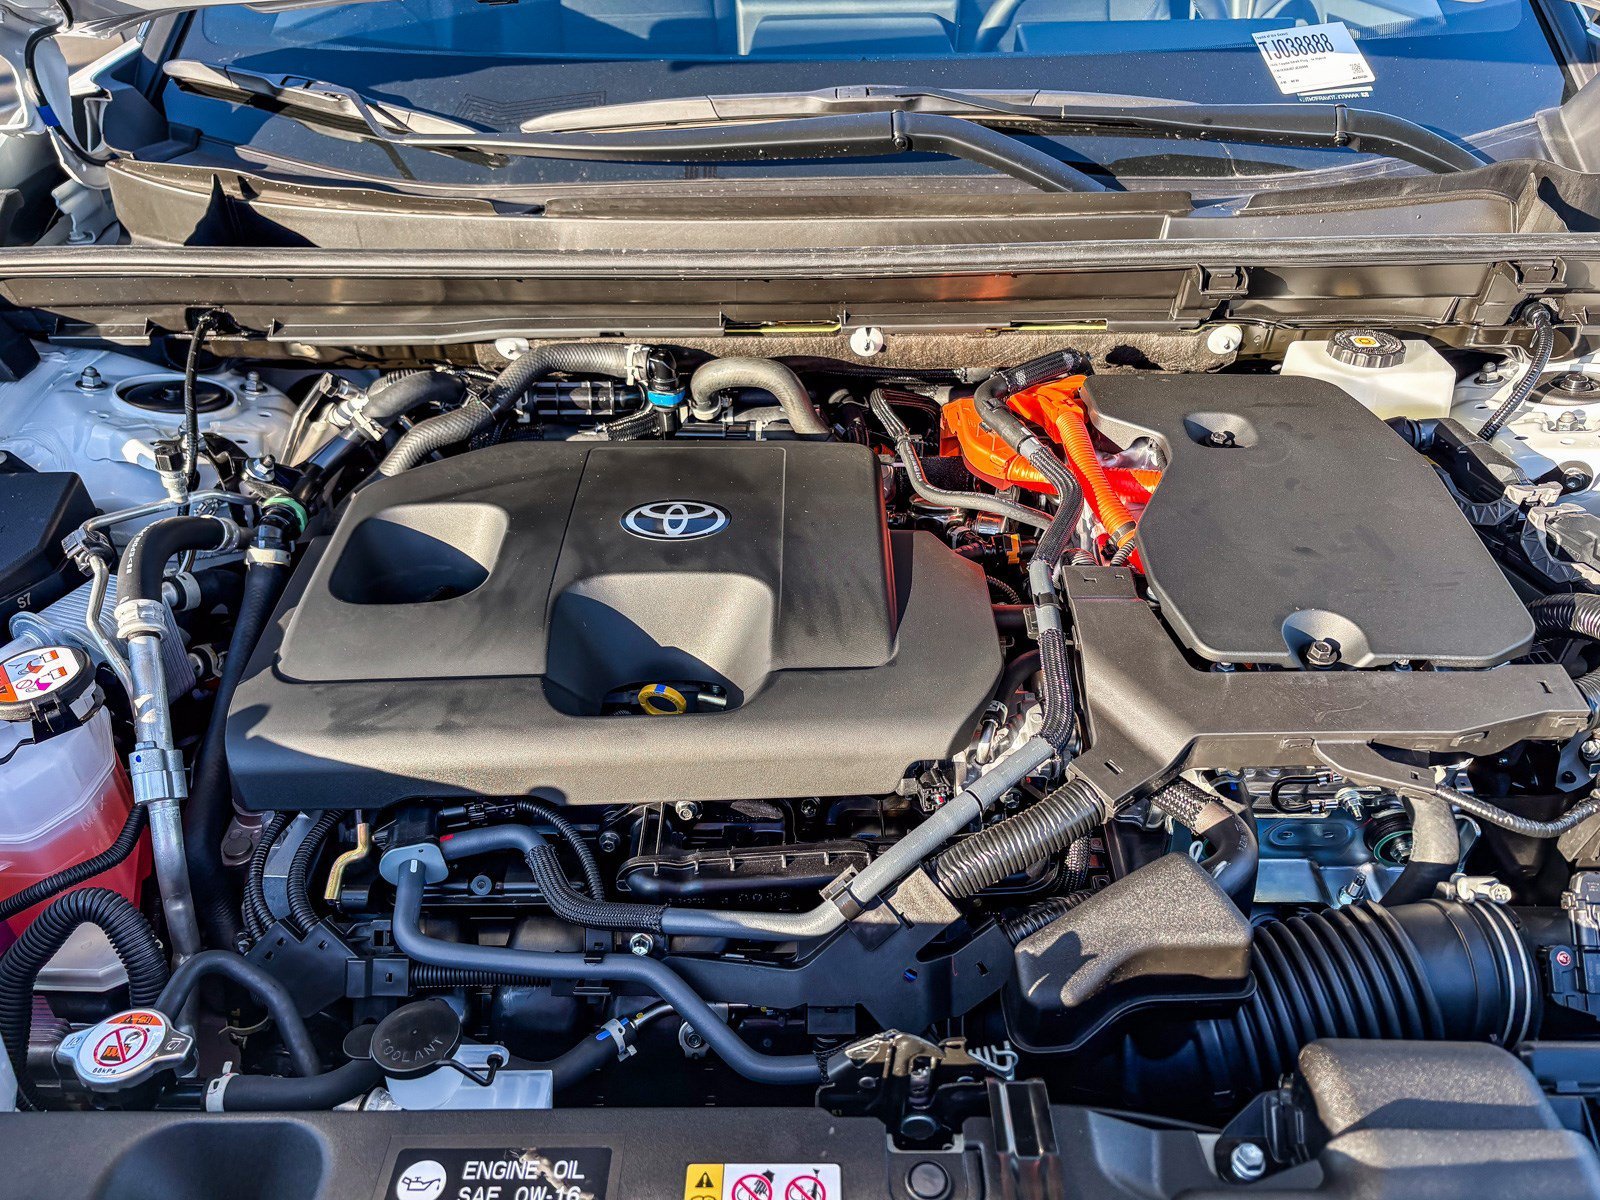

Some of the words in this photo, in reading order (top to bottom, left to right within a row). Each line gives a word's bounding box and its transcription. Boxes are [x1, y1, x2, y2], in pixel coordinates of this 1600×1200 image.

[1258, 33, 1334, 60] TJ038888
[381, 1038, 444, 1062] COOLANT
[462, 1161, 540, 1180] ENGINE
[553, 1160, 585, 1180] OIL
[457, 1186, 502, 1200] SAE
